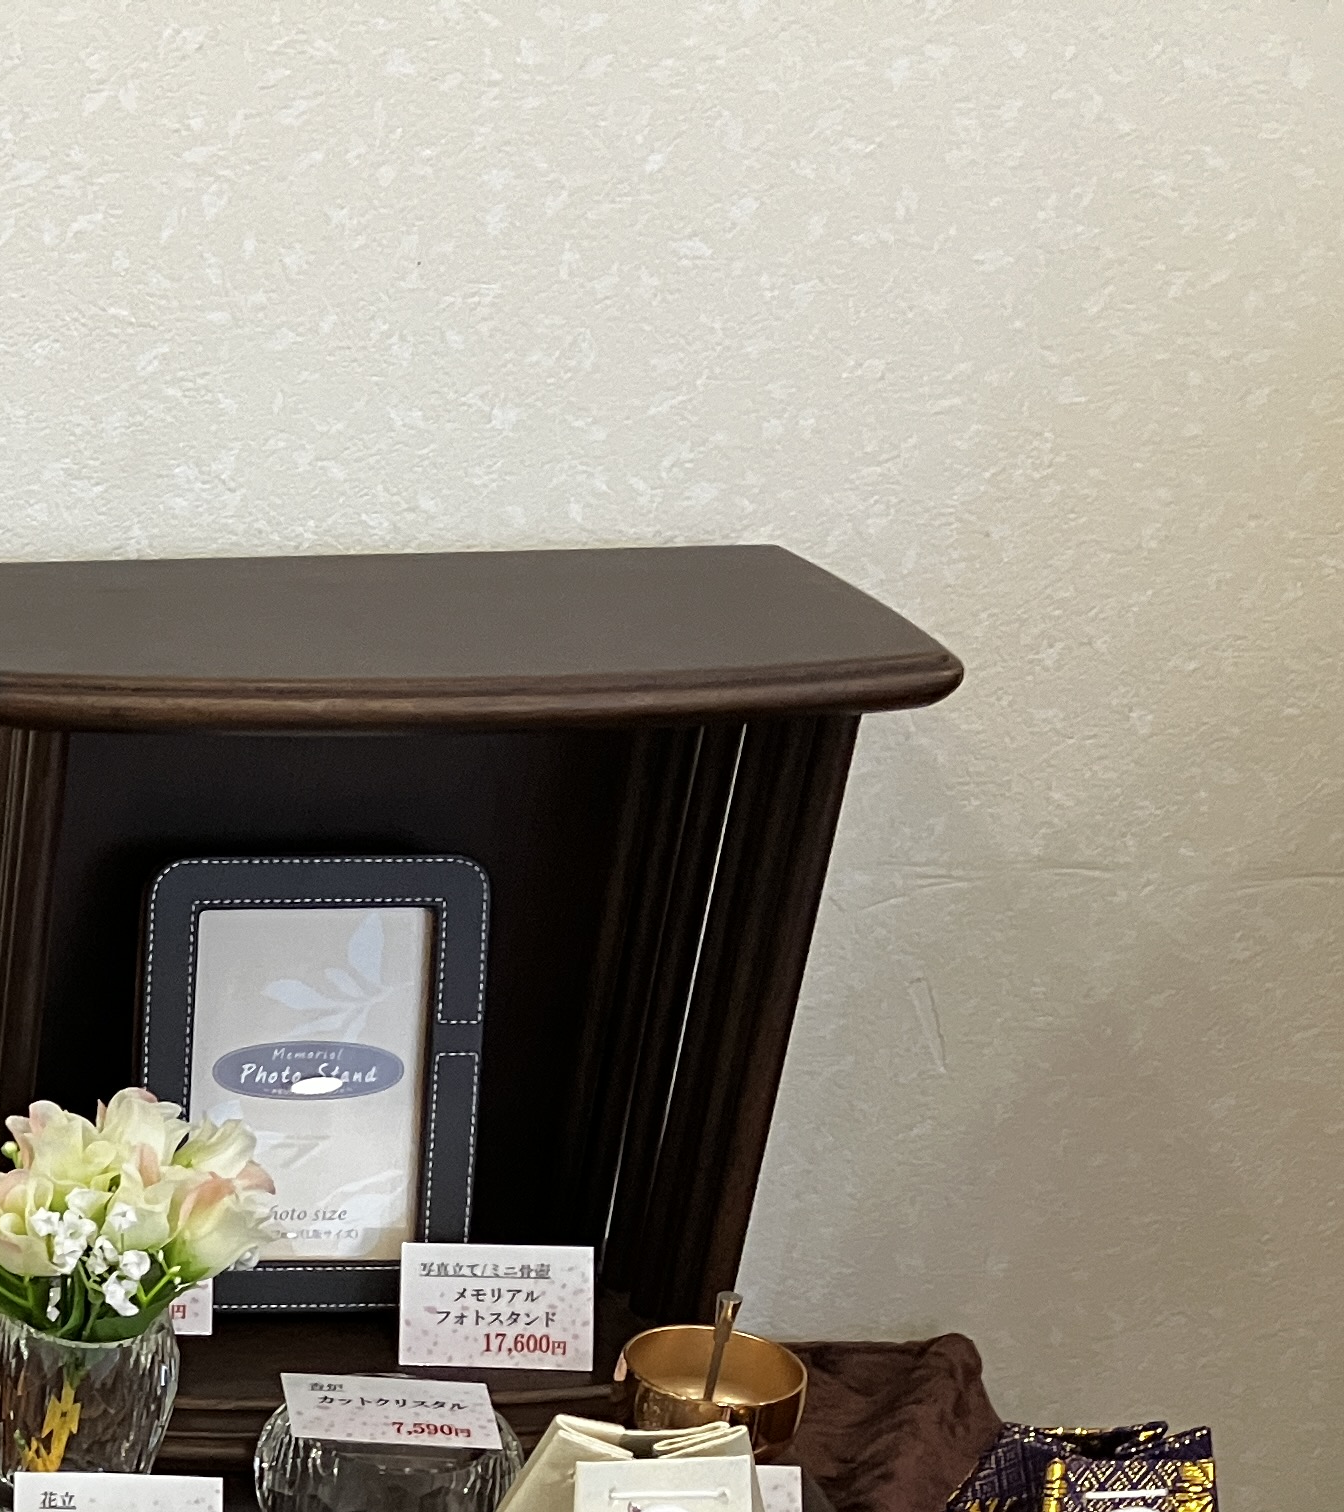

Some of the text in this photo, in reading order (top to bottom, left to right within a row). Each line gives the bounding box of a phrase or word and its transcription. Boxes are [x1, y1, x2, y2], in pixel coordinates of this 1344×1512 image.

[240, 1062, 379, 1084] Photo Stand
[312, 1209, 347, 1221] size
[454, 1288, 542, 1303] メモリアル
[436, 1310, 556, 1328] フォトスタンド
[484, 1333, 567, 1356] 17,600円
[318, 1396, 469, 1411] カットクリスタル
[392, 1421, 471, 1438] 7,590円
[40, 1491, 76, 1508] 花立
